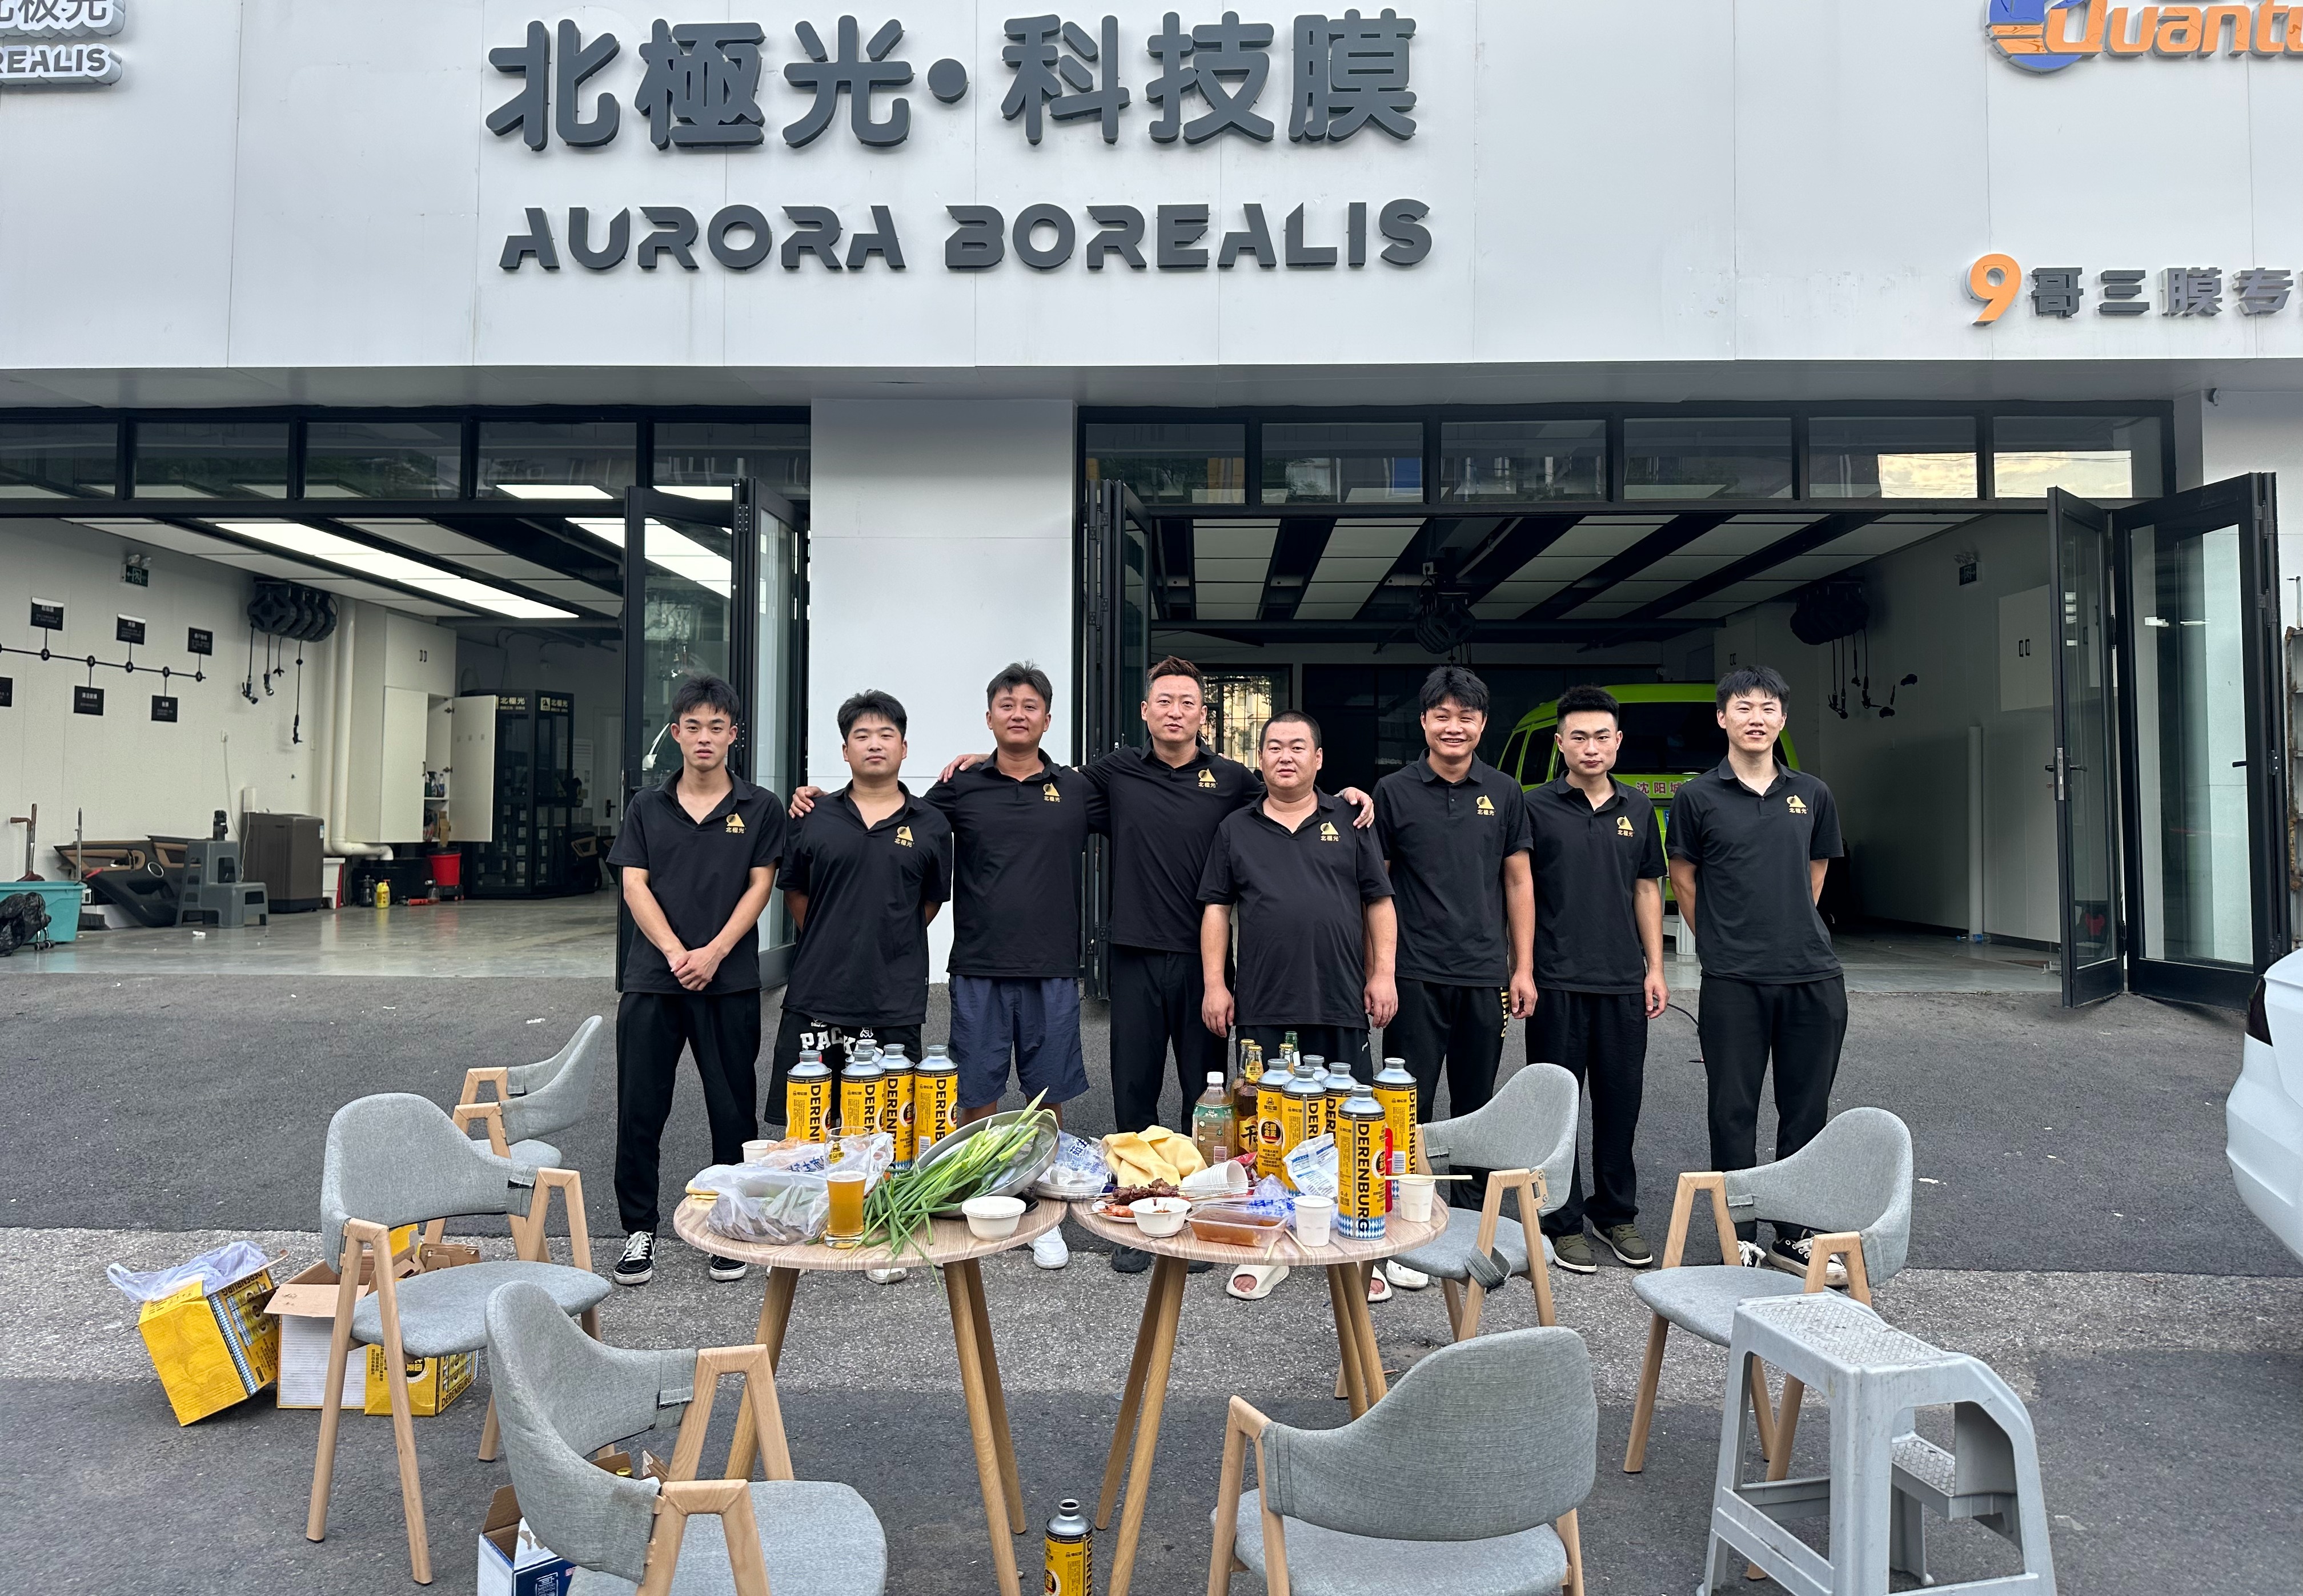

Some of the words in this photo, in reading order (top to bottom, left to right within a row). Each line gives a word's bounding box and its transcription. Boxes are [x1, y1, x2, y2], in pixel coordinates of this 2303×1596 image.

[0, 0, 107, 23] 极光
[0, 48, 106, 73] EALIS
[499, 204, 906, 271] AURORA
[945, 198, 1433, 270] BOREALIS
[1965, 254, 2303, 324] 9哥三膜专
[800, 1027, 859, 1055] PACK
[1357, 1123, 1370, 1232] DERENBURG
[442, 1374, 472, 1408] DERENBURG
